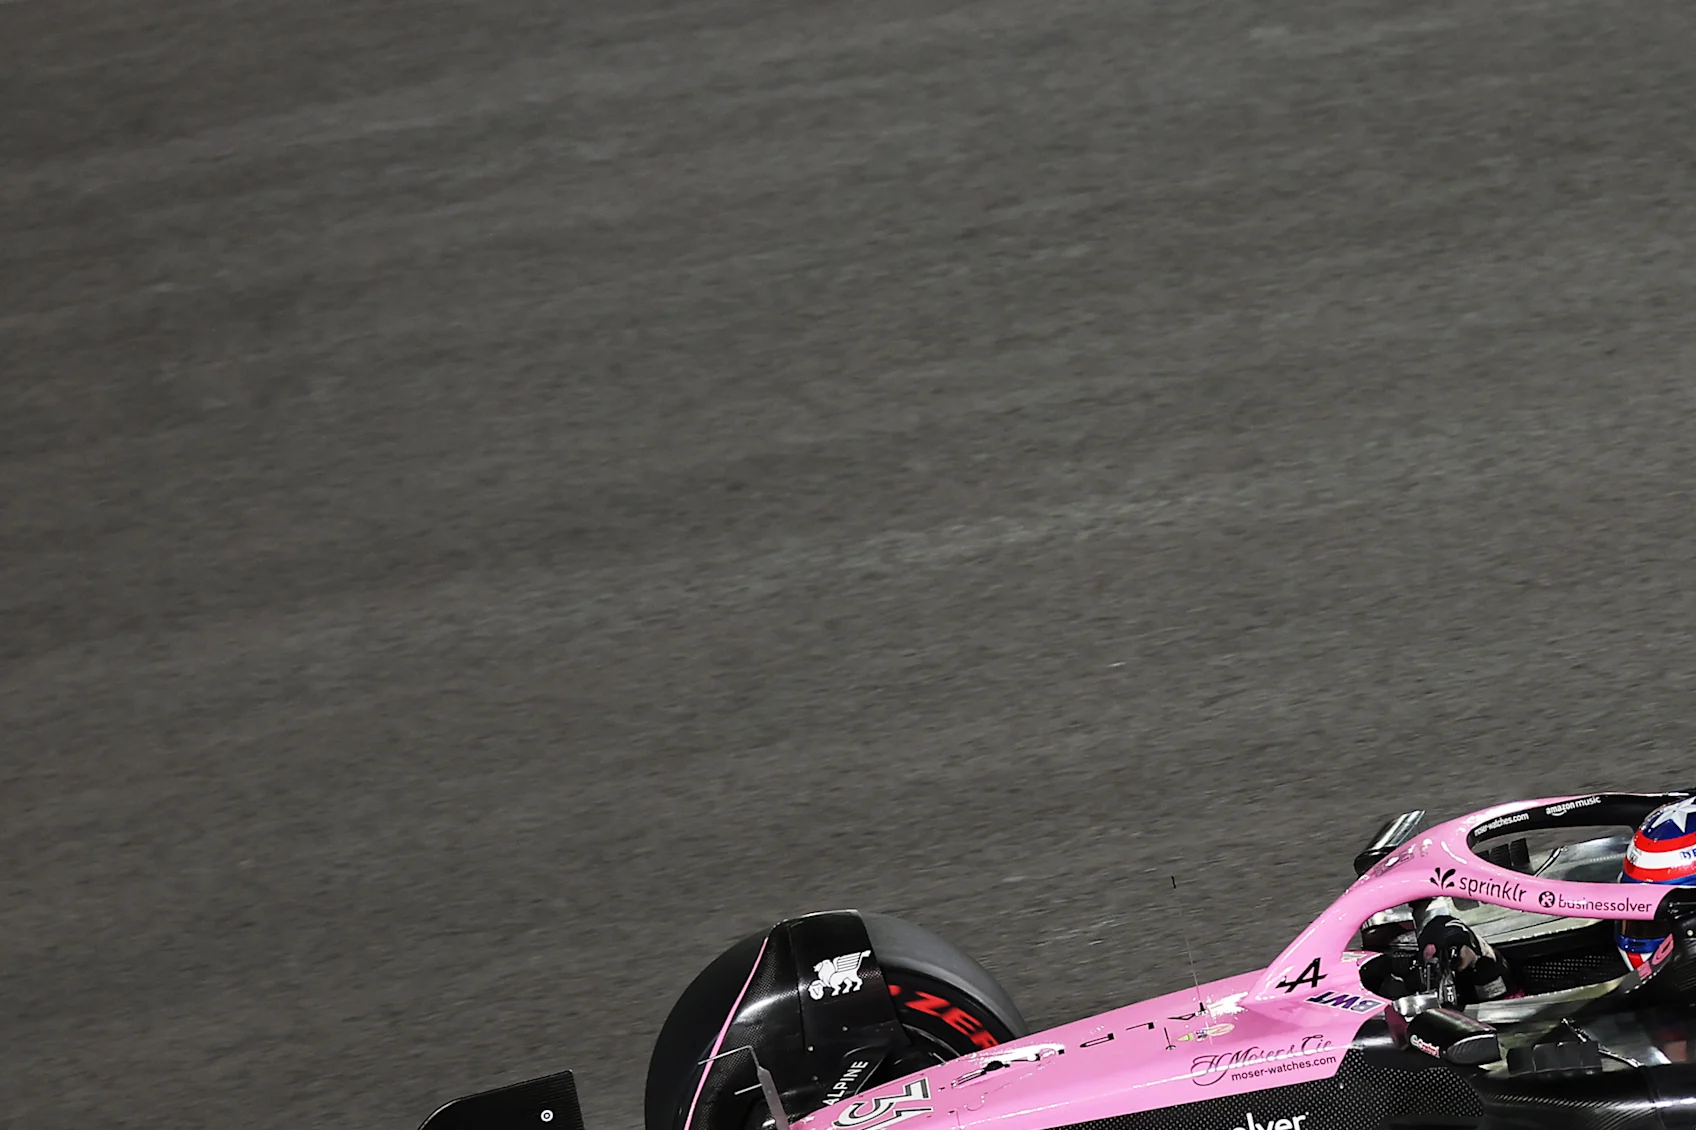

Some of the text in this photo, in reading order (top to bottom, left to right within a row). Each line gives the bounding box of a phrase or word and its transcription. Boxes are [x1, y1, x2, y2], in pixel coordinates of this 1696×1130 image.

[1545, 795, 1602, 817] amazon music
[1459, 874, 1528, 903] sprinklr
[1558, 893, 1653, 914] businessolver
[904, 990, 1000, 1050] ZER
[1231, 1055, 1337, 1081] moser-watches.com
[823, 1060, 869, 1106] ALPINE
